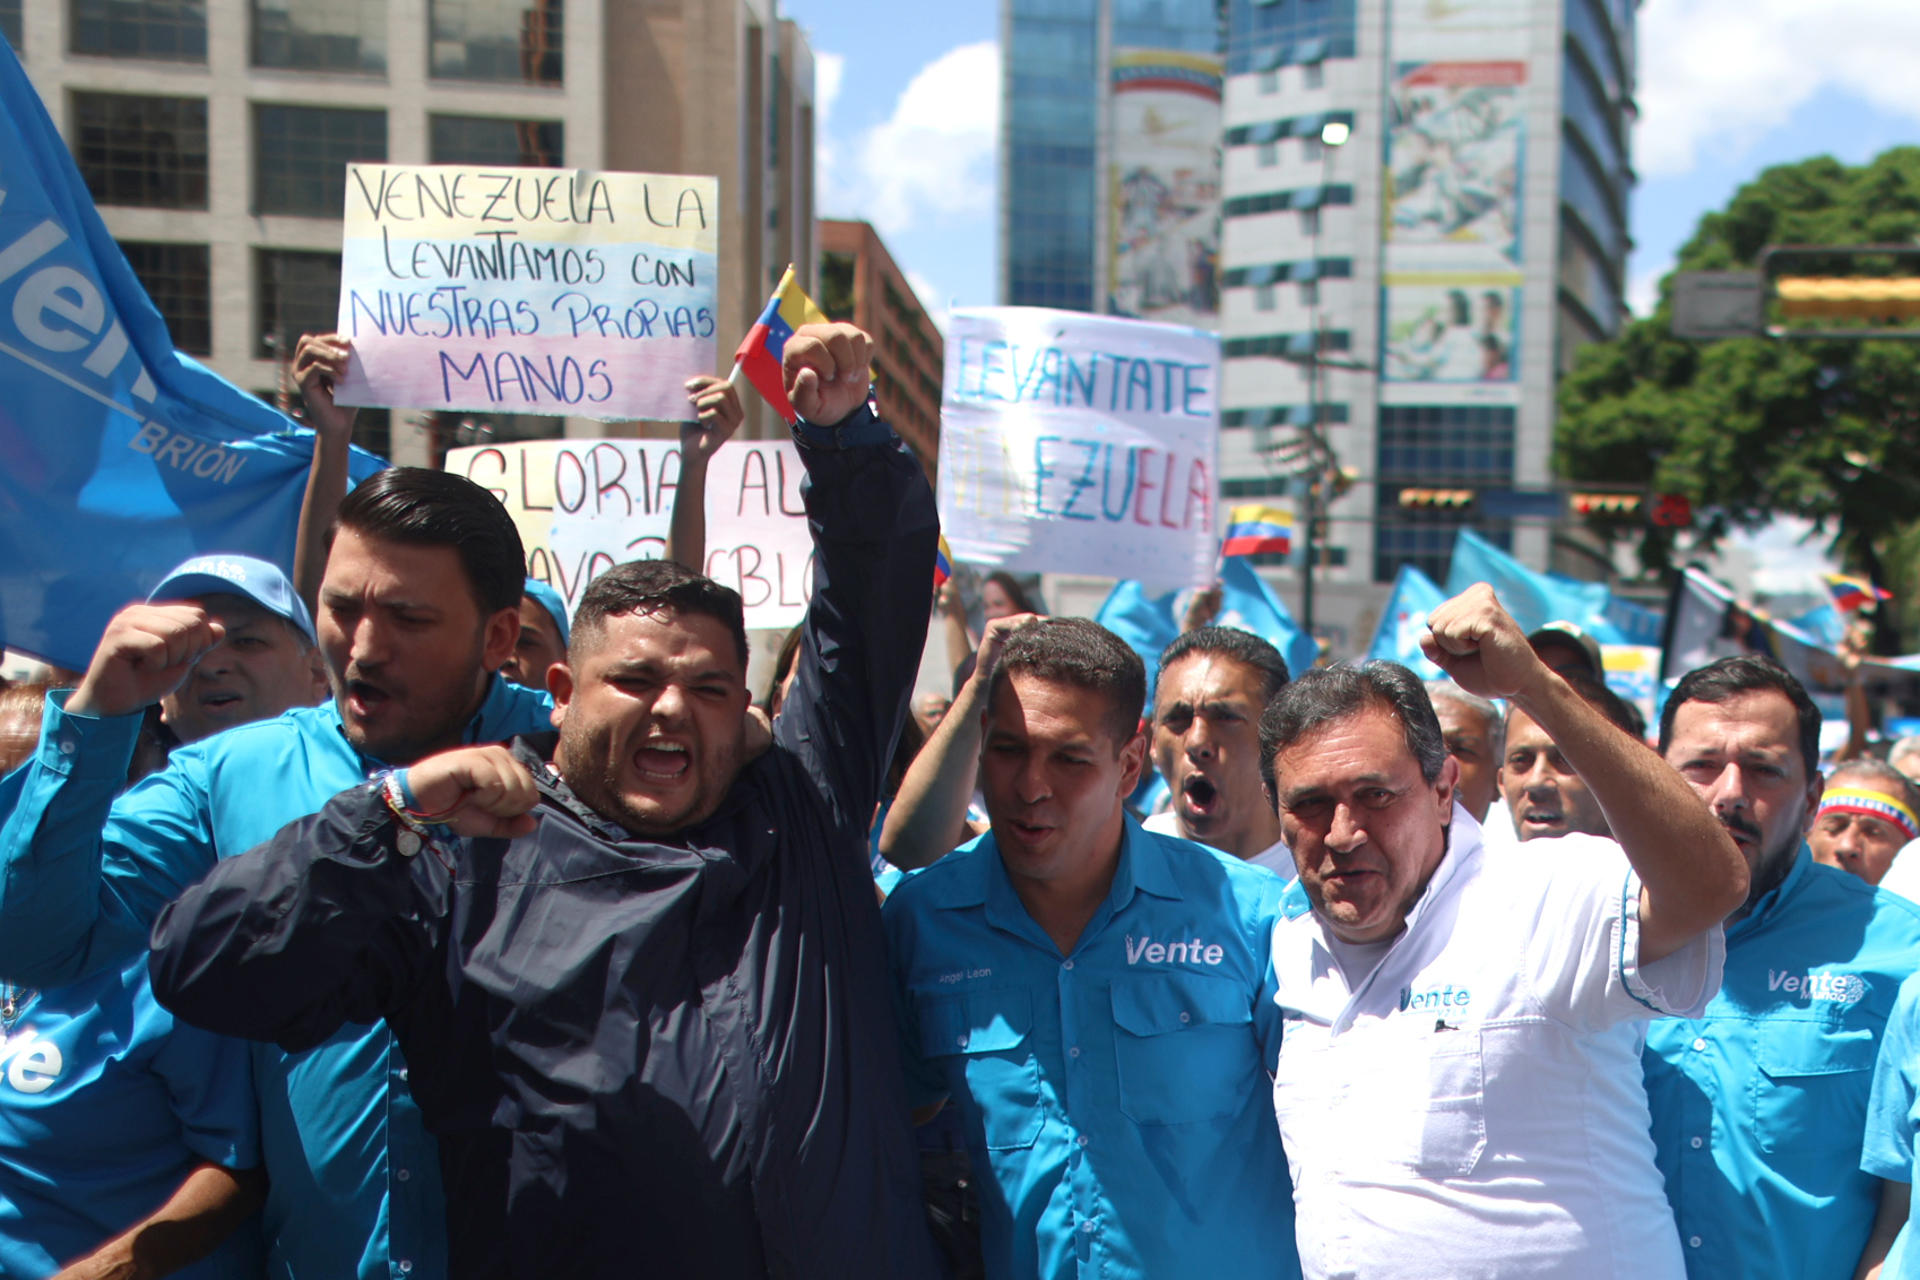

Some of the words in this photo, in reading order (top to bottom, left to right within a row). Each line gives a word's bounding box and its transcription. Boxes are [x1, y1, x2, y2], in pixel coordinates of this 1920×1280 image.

[352, 168, 615, 223] VENEZUELA
[644, 183, 706, 229] LA
[383, 225, 605, 284] LEVANTAMOS
[631, 253, 694, 287] CON
[350, 286, 539, 339] NUESTRAS
[551, 292, 714, 340] PROPIAS
[438, 351, 613, 403] MANOS
[737, 449, 807, 517] AL
[1125, 934, 1224, 966] Vente
[1400, 984, 1471, 1012] Vente
[1768, 969, 1847, 993] Vente
